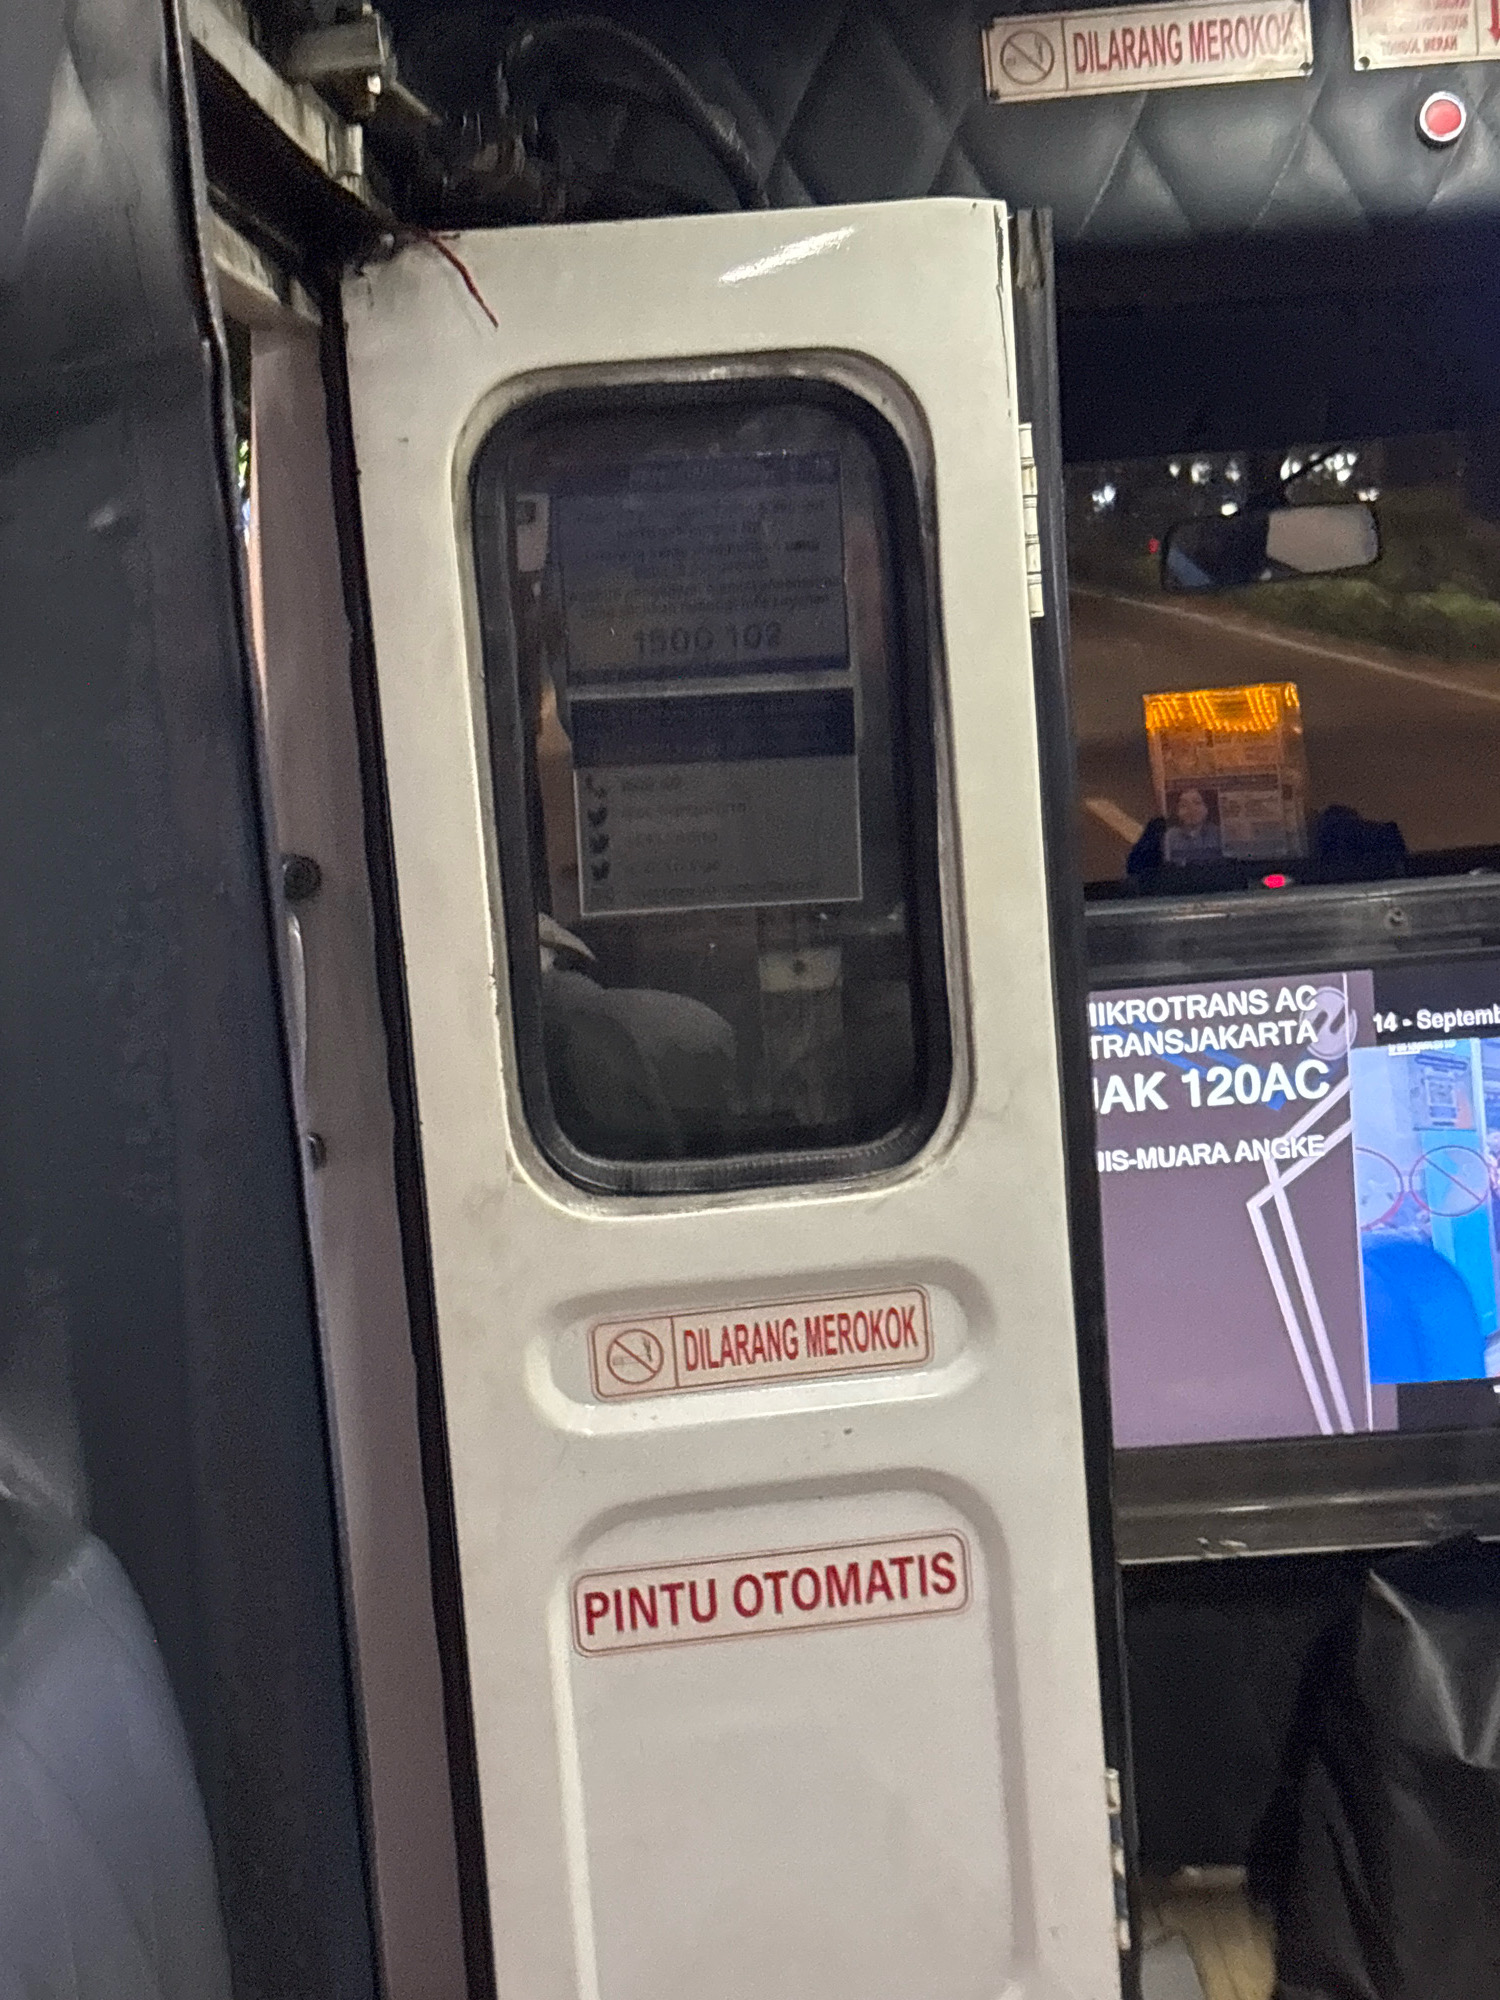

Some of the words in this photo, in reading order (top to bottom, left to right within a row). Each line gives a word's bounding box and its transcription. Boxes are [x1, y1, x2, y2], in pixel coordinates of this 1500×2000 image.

[1073, 23, 1183, 75] DILARANG
[1189, 10, 1298, 64] MEROKOK
[1275, 985, 1318, 1013] AC
[1373, 1011, 1398, 1033] 14
[1093, 1071, 1169, 1115] AK
[1181, 1058, 1330, 1108] 120AC
[1234, 1134, 1326, 1163] ANGKE
[684, 1317, 799, 1372] DILARANG
[804, 1304, 918, 1358] MEROKOK
[584, 1577, 718, 1636] PINTU
[733, 1551, 957, 1619] OTOMATIS
